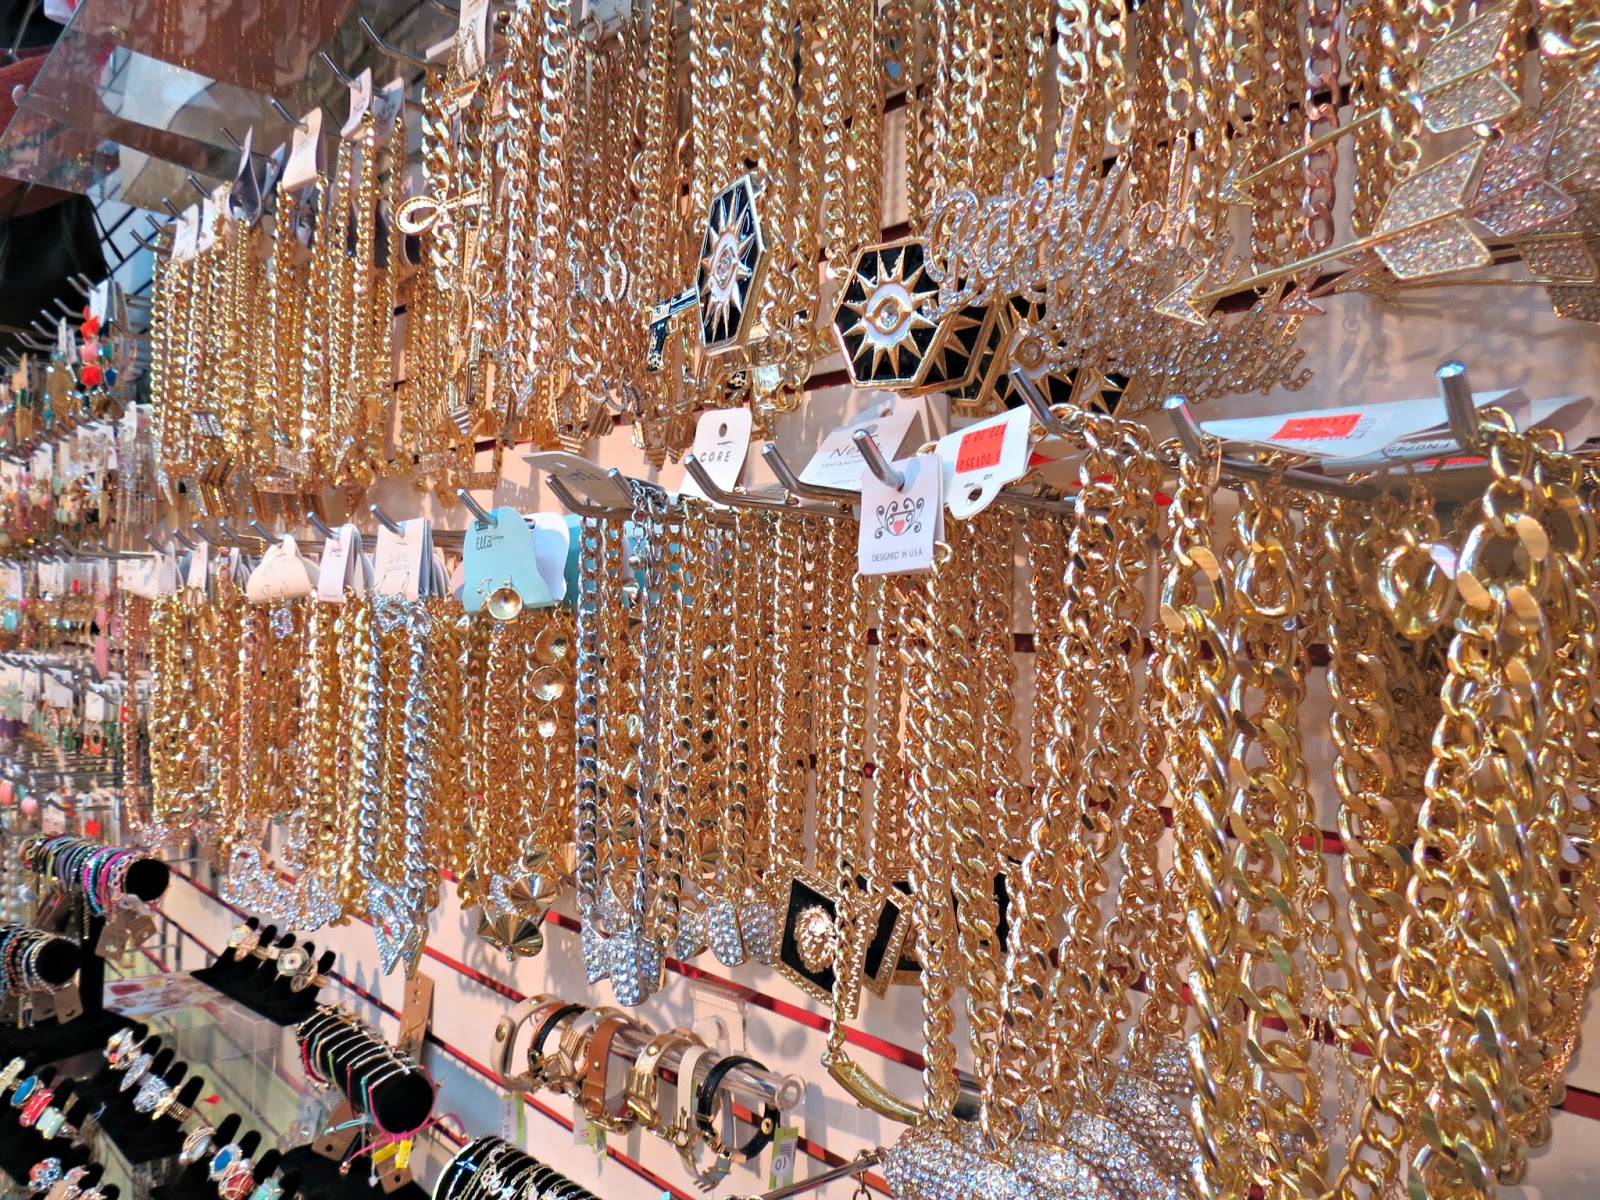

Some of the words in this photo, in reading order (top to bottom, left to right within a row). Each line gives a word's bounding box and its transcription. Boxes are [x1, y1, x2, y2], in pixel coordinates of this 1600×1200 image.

[700, 451, 732, 463] CORE
[475, 535, 497, 551] Ella
[872, 551, 899, 562] DESIGNED
[901, 549, 907, 559] IN
